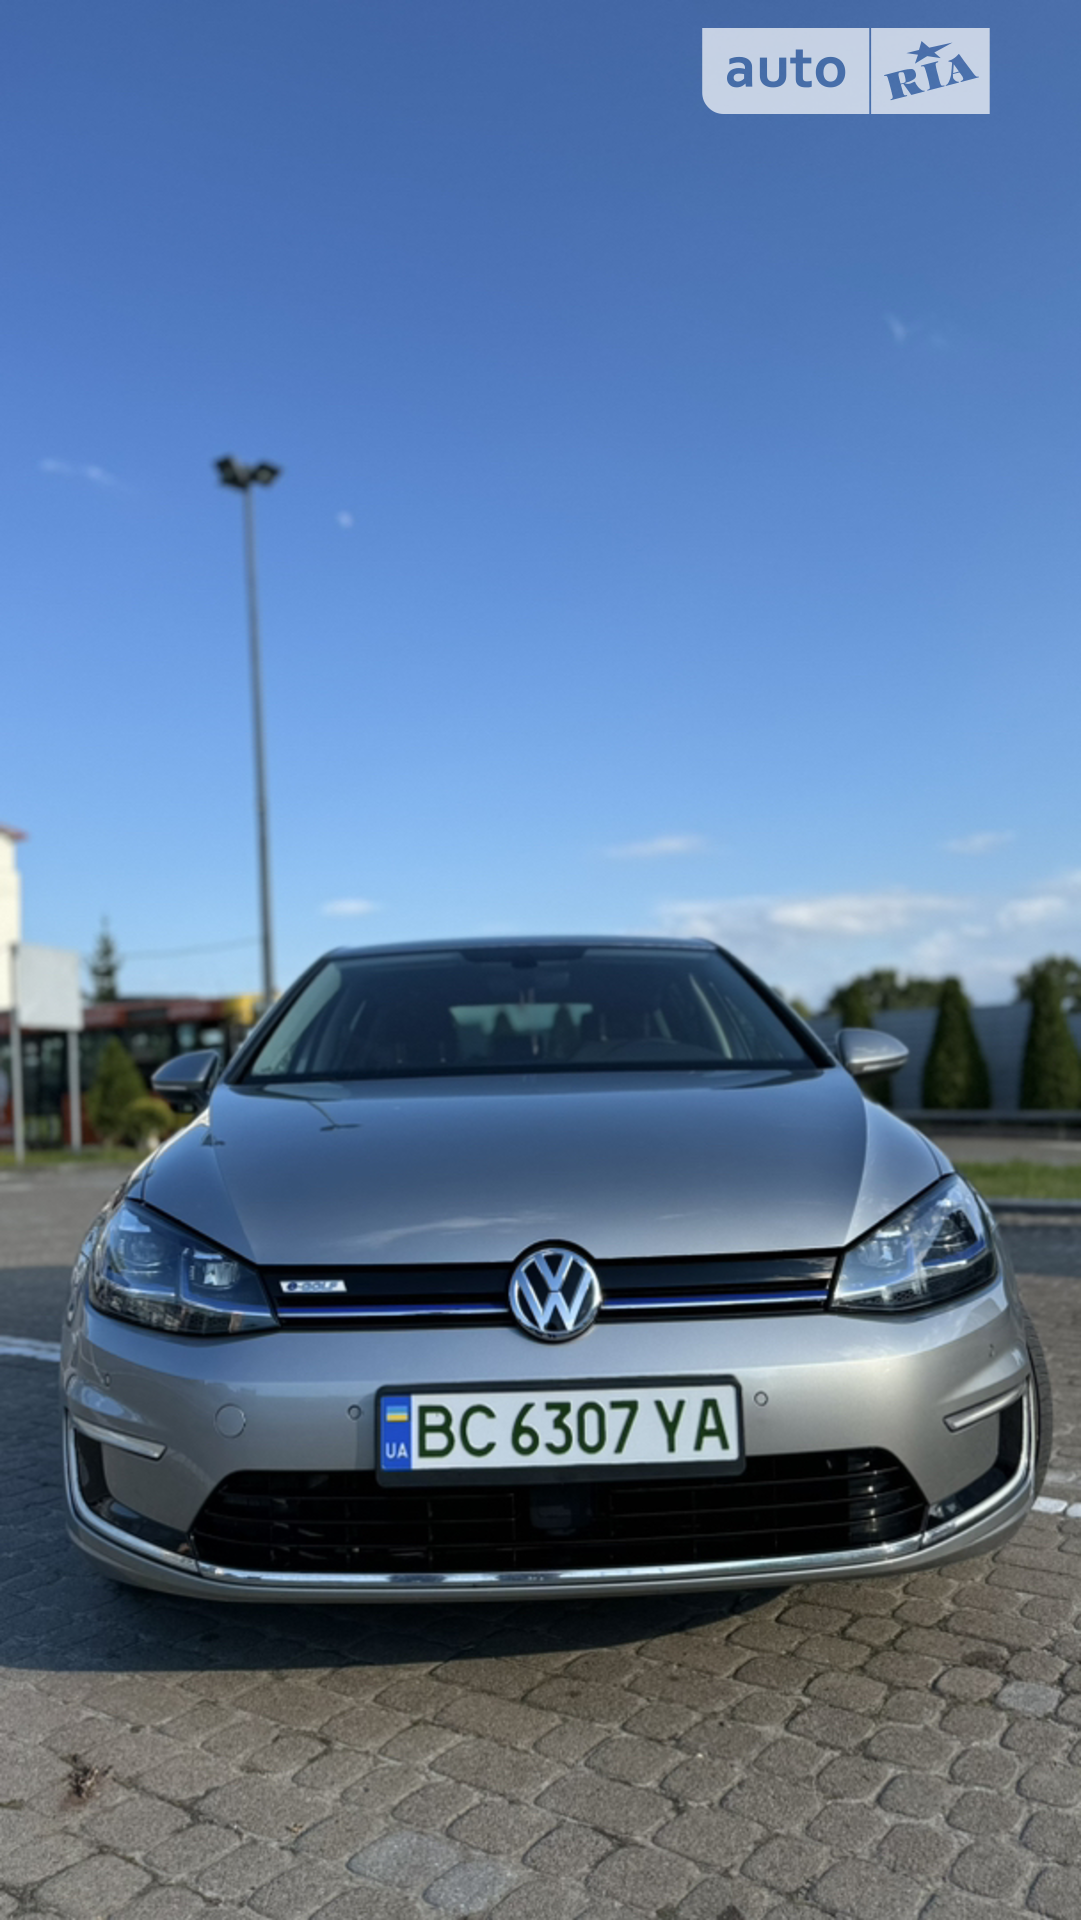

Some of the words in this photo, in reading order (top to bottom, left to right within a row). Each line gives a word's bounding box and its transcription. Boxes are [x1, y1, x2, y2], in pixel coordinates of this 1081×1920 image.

[418, 1404, 497, 1458] BC
[511, 1400, 639, 1456] 6307
[654, 1398, 730, 1453] YA
[385, 1442, 408, 1459] UA
